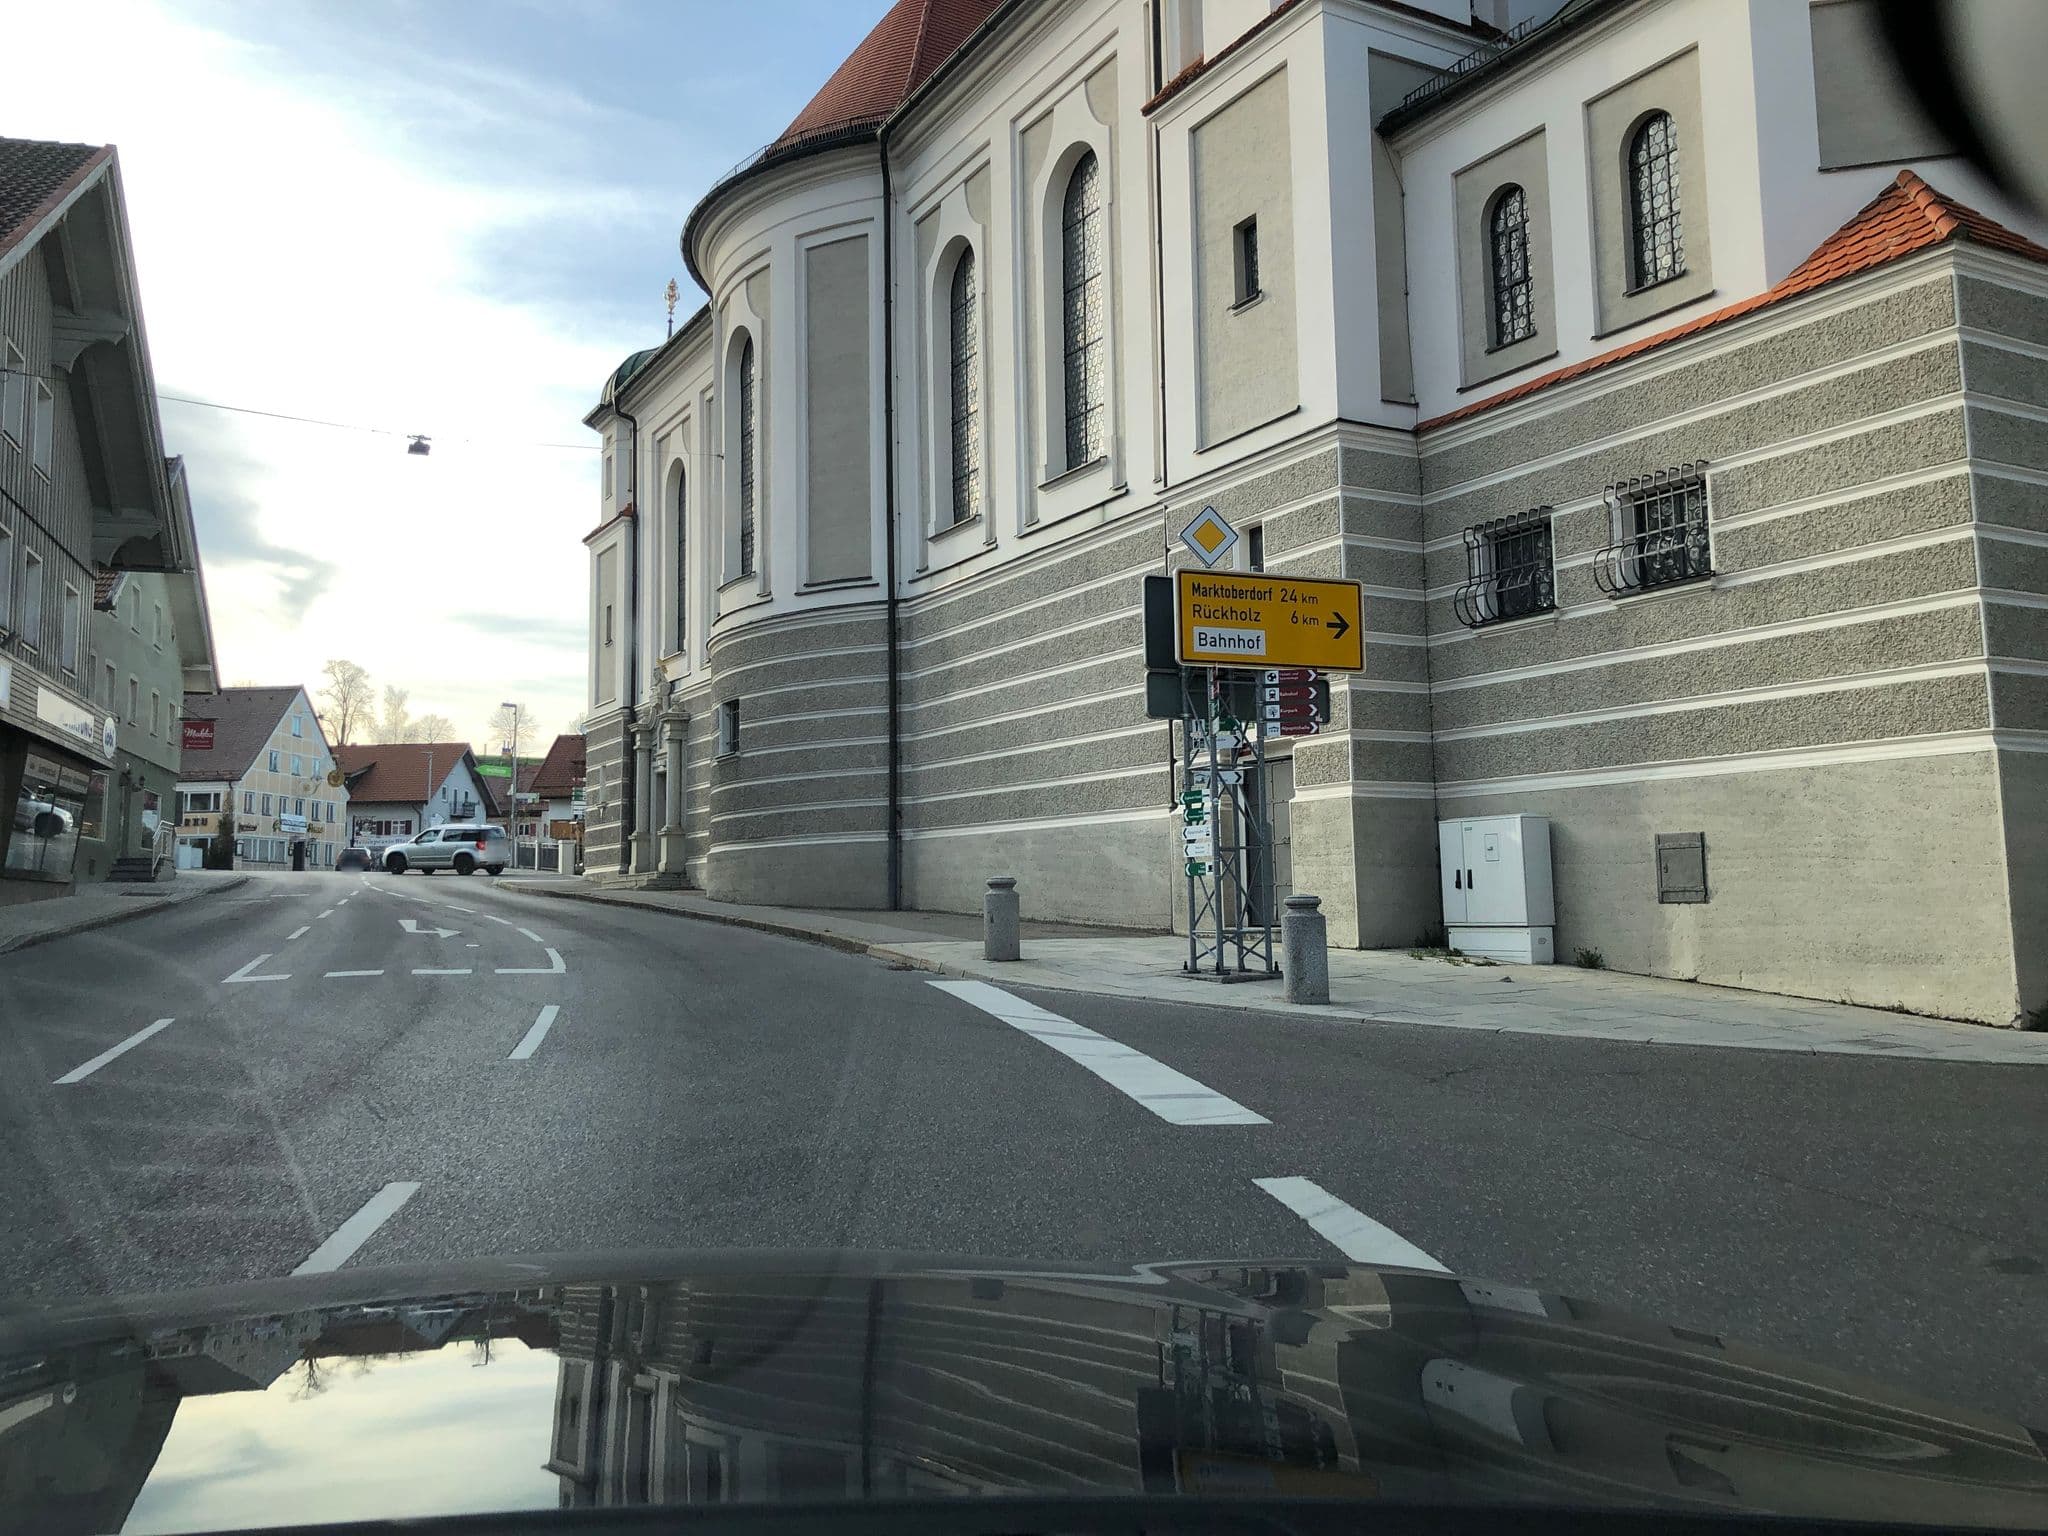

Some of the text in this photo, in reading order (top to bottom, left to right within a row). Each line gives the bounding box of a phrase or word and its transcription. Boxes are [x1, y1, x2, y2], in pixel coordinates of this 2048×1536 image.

[1192, 582, 1319, 605] Marktoberdorf 24 km
[1192, 603, 1319, 626] Rückholz 6 km
[1198, 632, 1261, 649] Bahnhof
